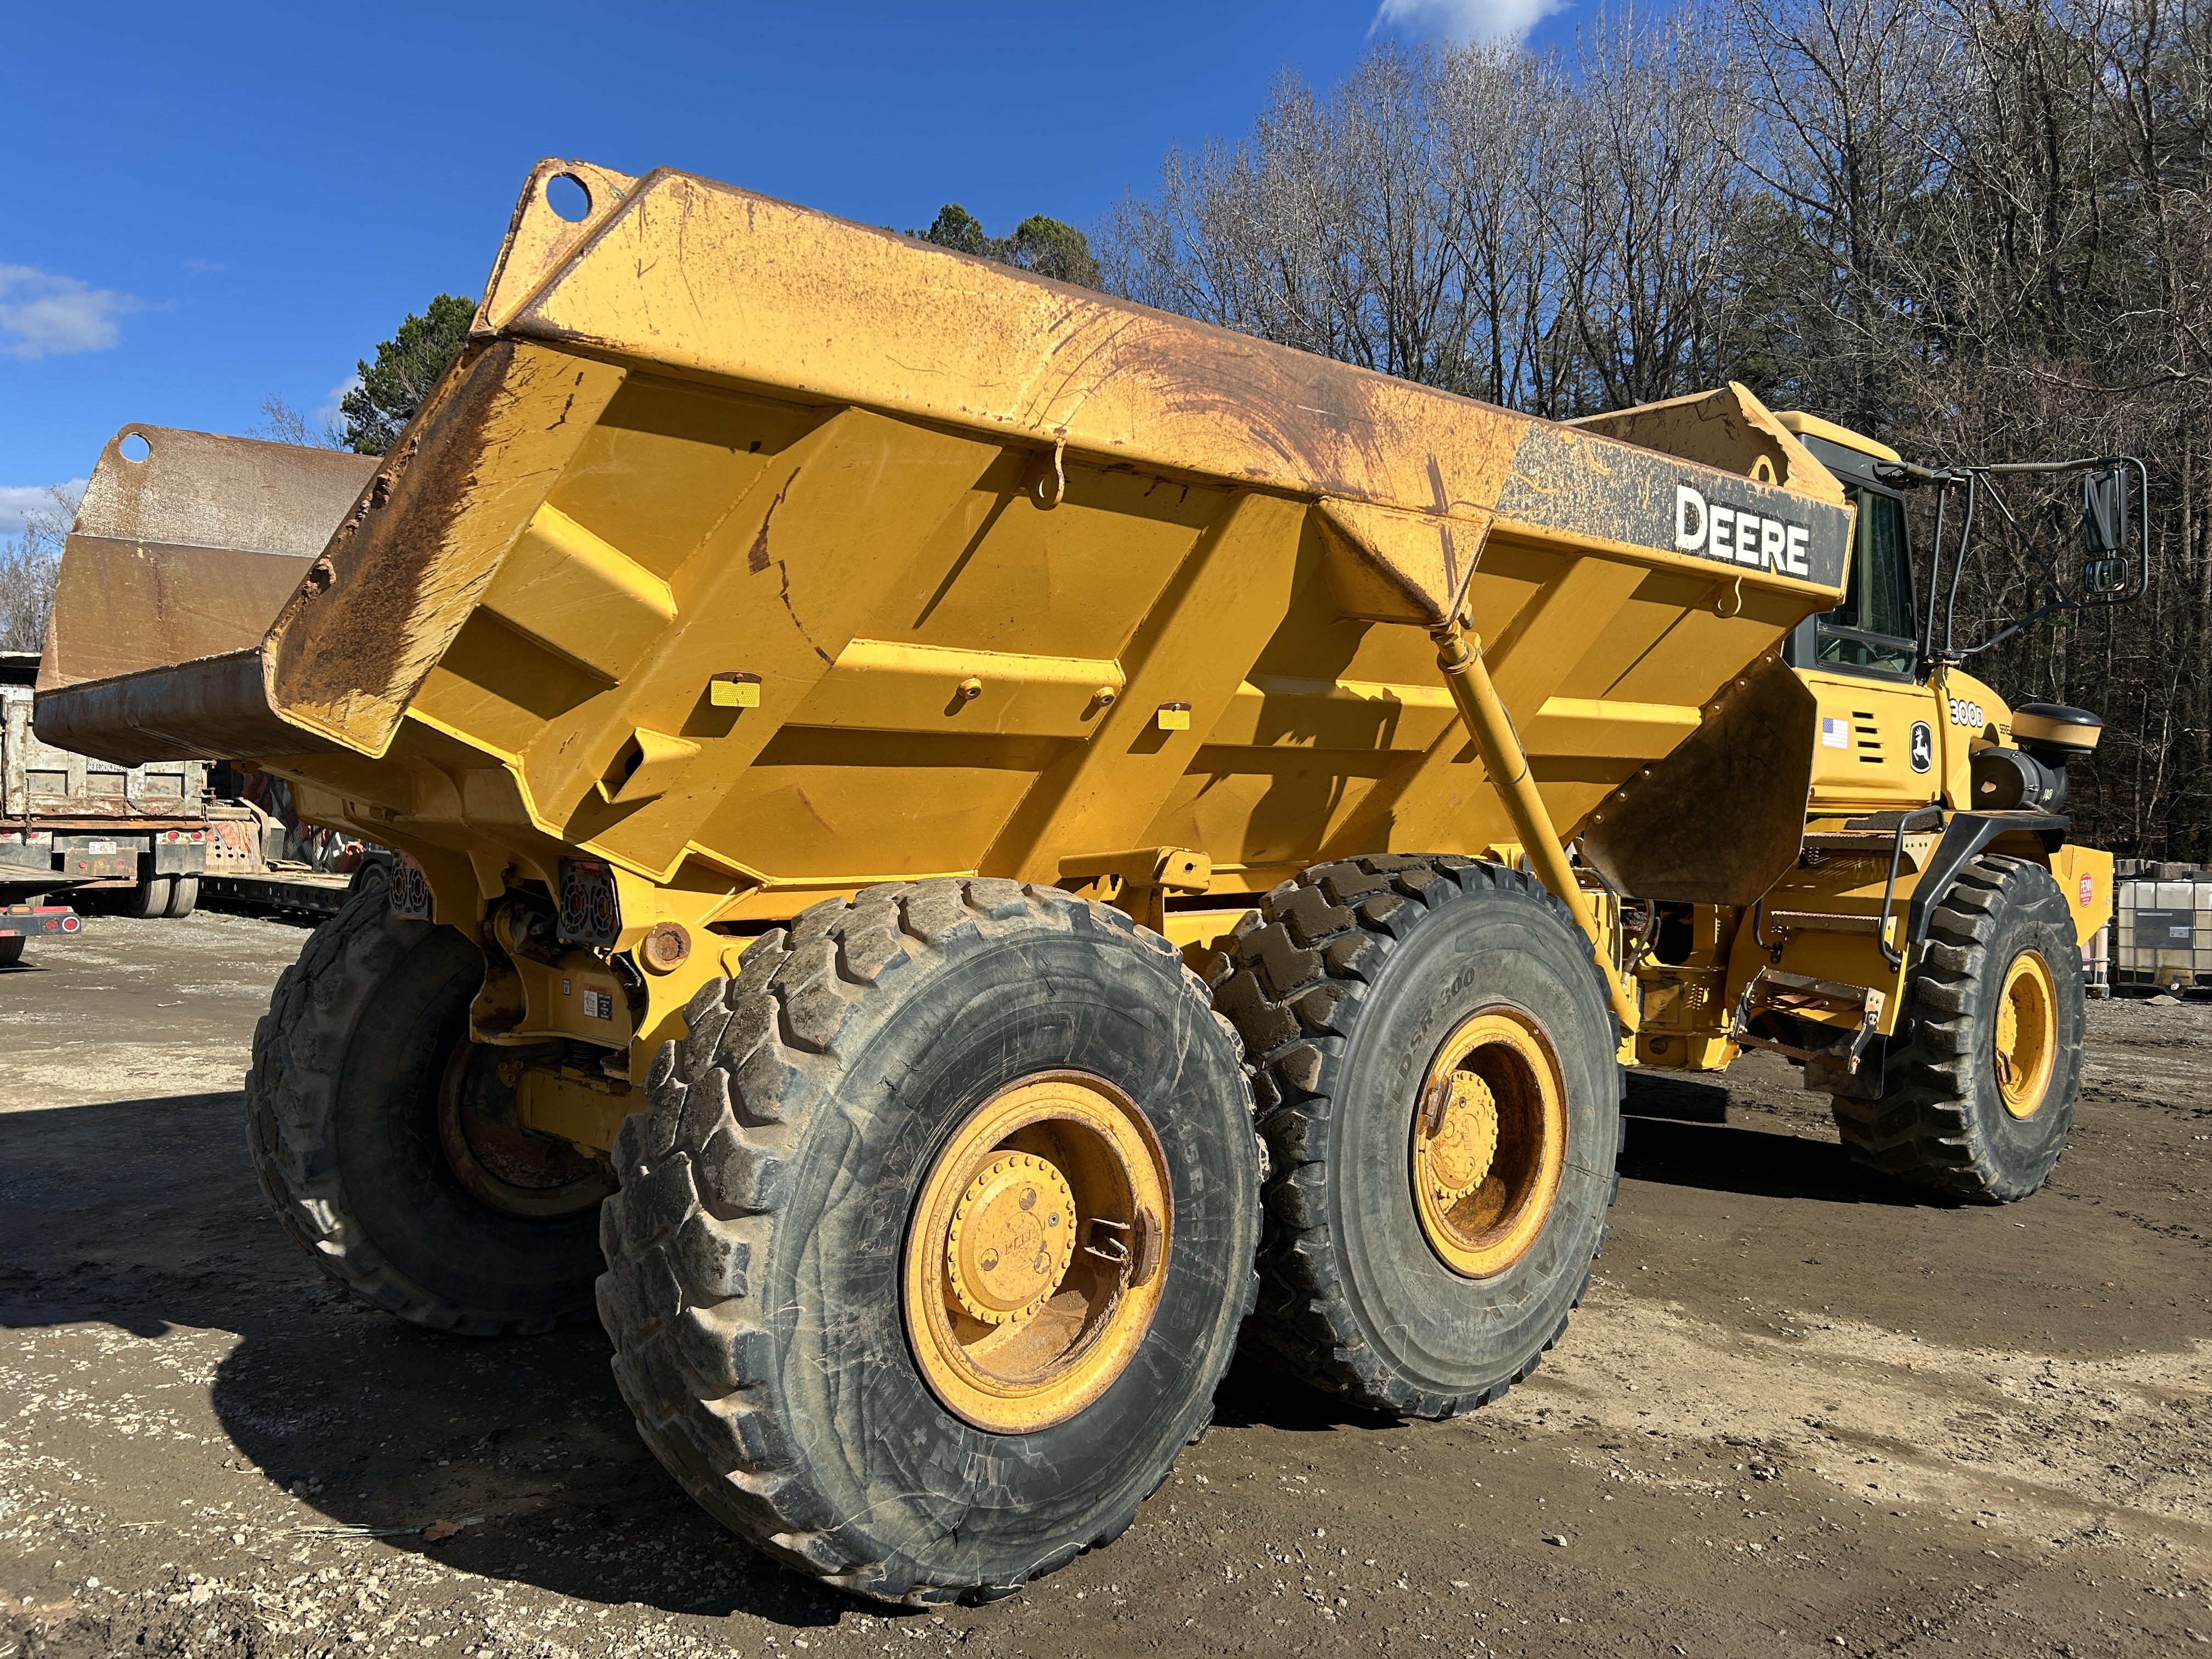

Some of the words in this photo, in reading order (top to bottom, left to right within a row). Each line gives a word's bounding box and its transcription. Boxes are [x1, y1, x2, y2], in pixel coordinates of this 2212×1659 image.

[1675, 484, 1809, 576] DEERE
[1949, 698, 1983, 727] 300D
[1440, 967, 1475, 1008] 300
